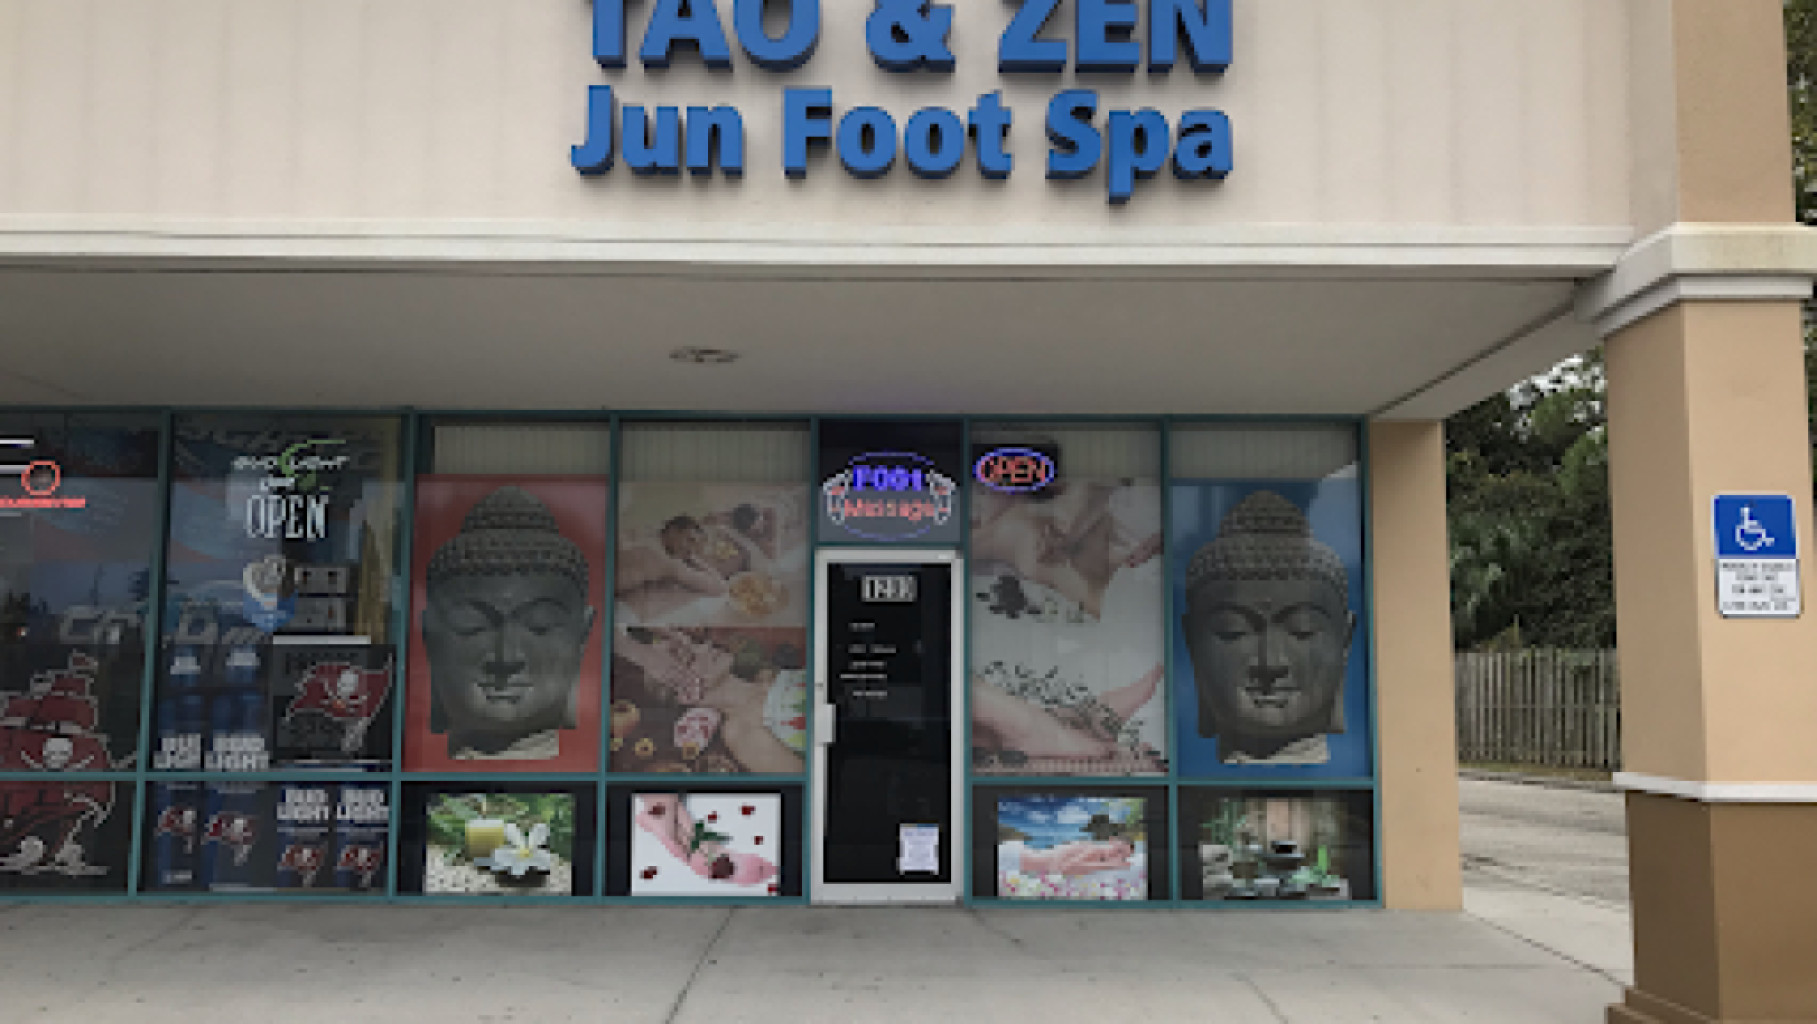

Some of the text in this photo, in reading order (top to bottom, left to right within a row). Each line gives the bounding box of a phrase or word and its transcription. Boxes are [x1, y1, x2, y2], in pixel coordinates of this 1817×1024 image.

[587, 0, 1234, 73] TAO & ZEN
[571, 86, 1234, 204] Jun Foot Spa
[979, 455, 1047, 484] OPEN
[246, 495, 329, 541] OPEN
